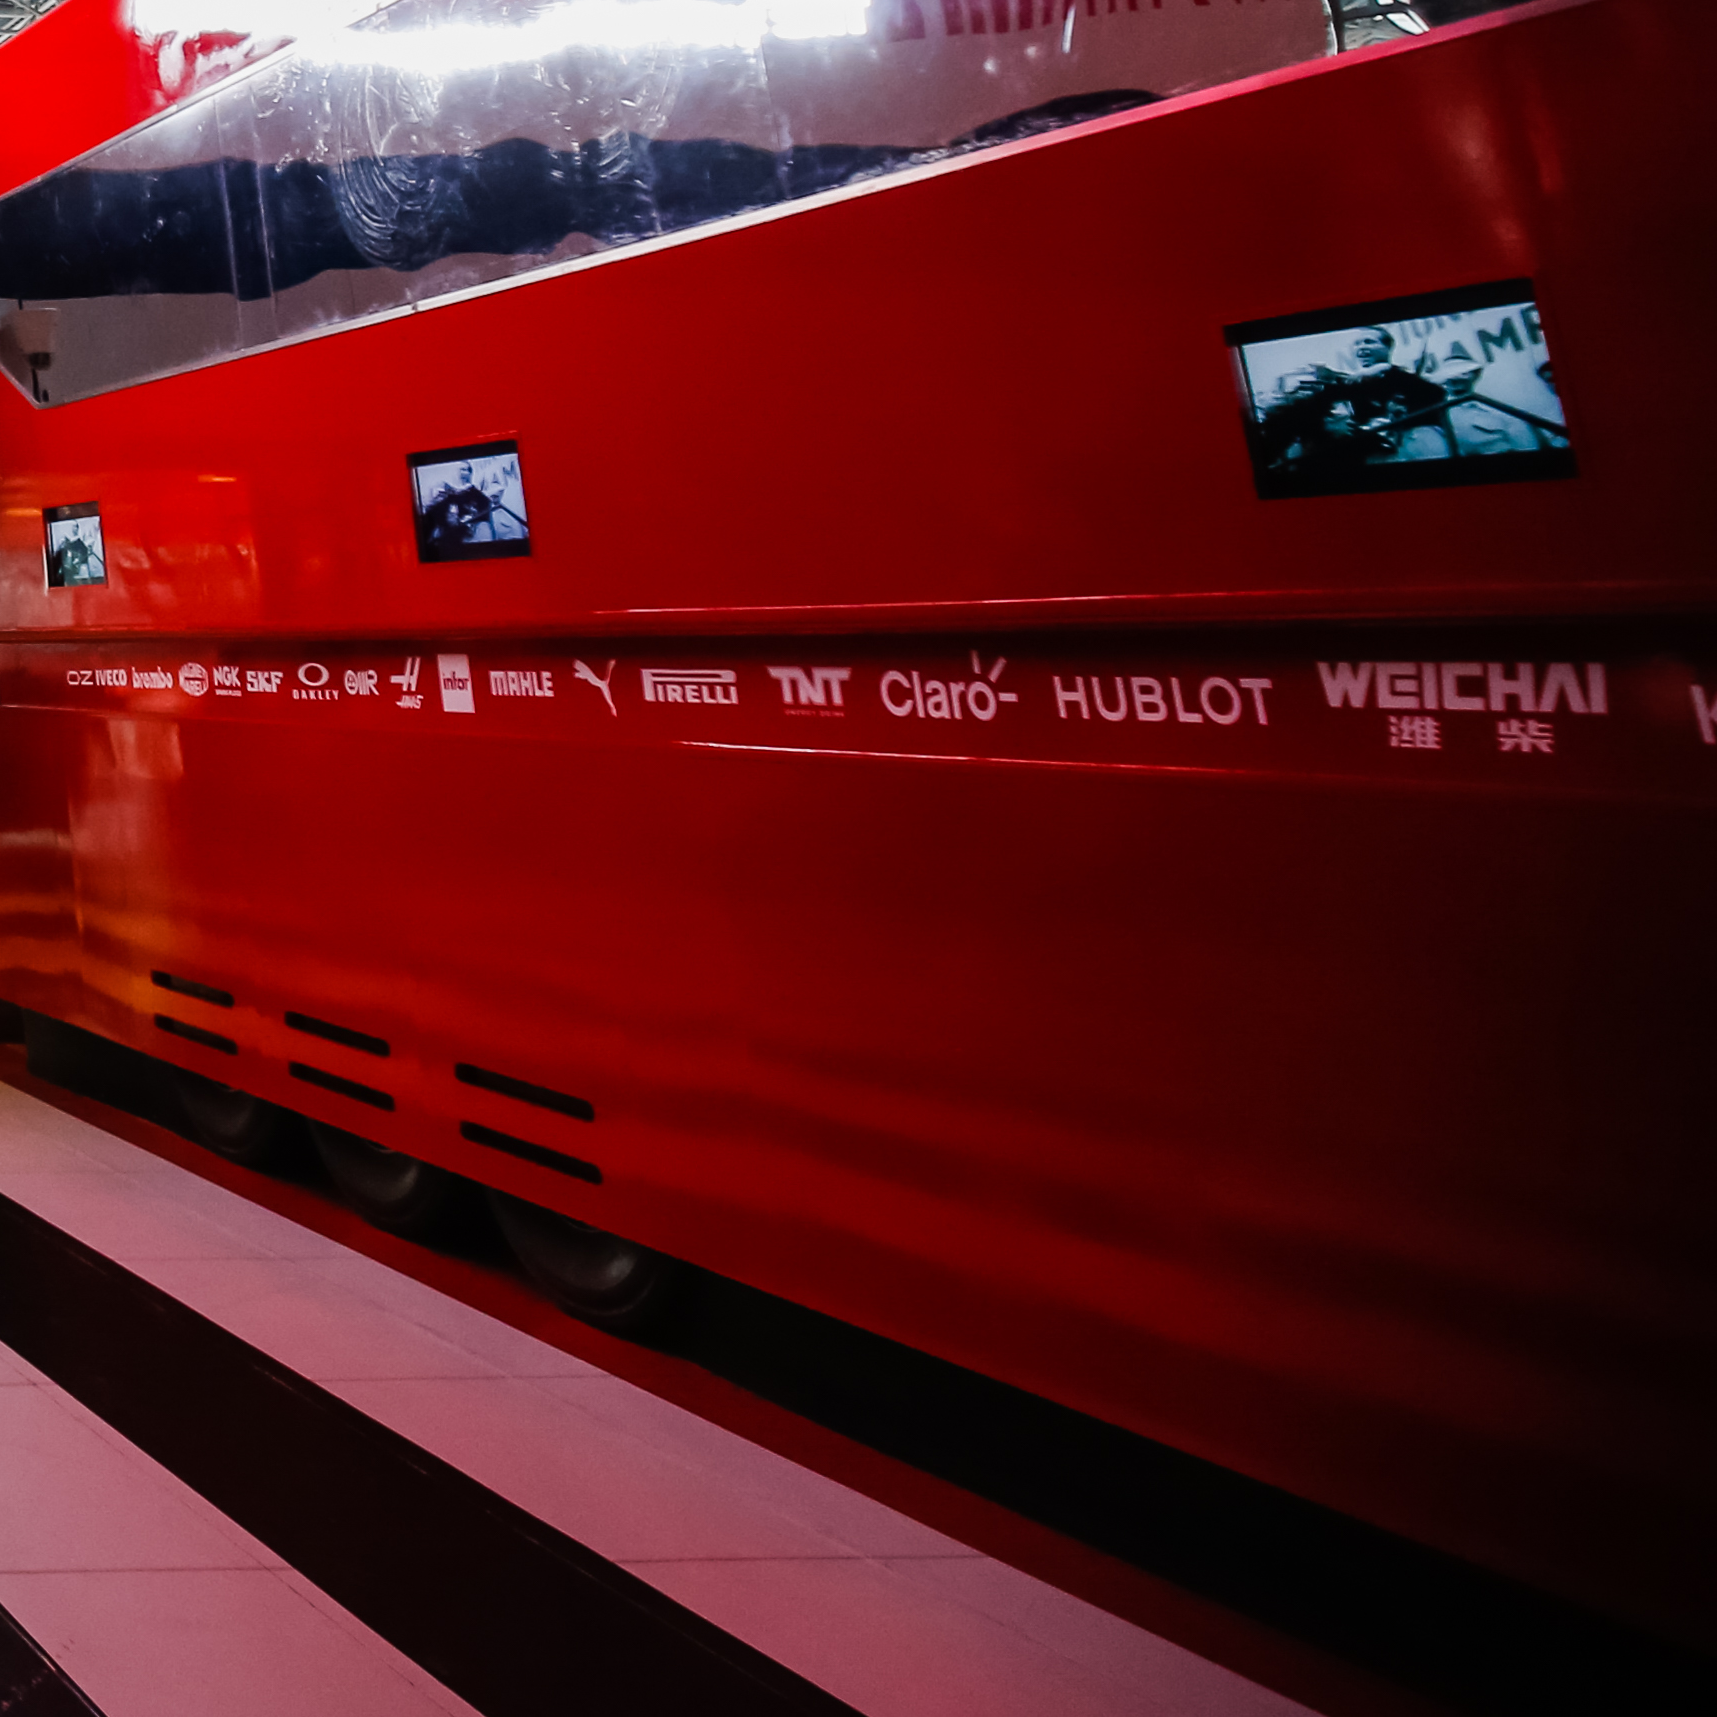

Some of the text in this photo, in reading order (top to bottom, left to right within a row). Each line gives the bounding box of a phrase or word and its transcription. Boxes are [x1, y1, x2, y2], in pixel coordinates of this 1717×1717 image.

[67, 670, 93, 685] OZ
[95, 669, 128, 687] IVECO
[131, 666, 173, 689] brembo
[212, 666, 241, 687] NGK
[246, 670, 284, 693] SKF
[442, 670, 469, 691] infor
[489, 670, 555, 697] MAHLE
[640, 668, 738, 705] PIRELLI
[767, 666, 852, 706] TNT
[1317, 662, 1608, 714] WEICHAI
[292, 689, 339, 700] OAKLEY
[880, 668, 998, 721] Claro
[1052, 675, 1273, 725] HUBLOT
